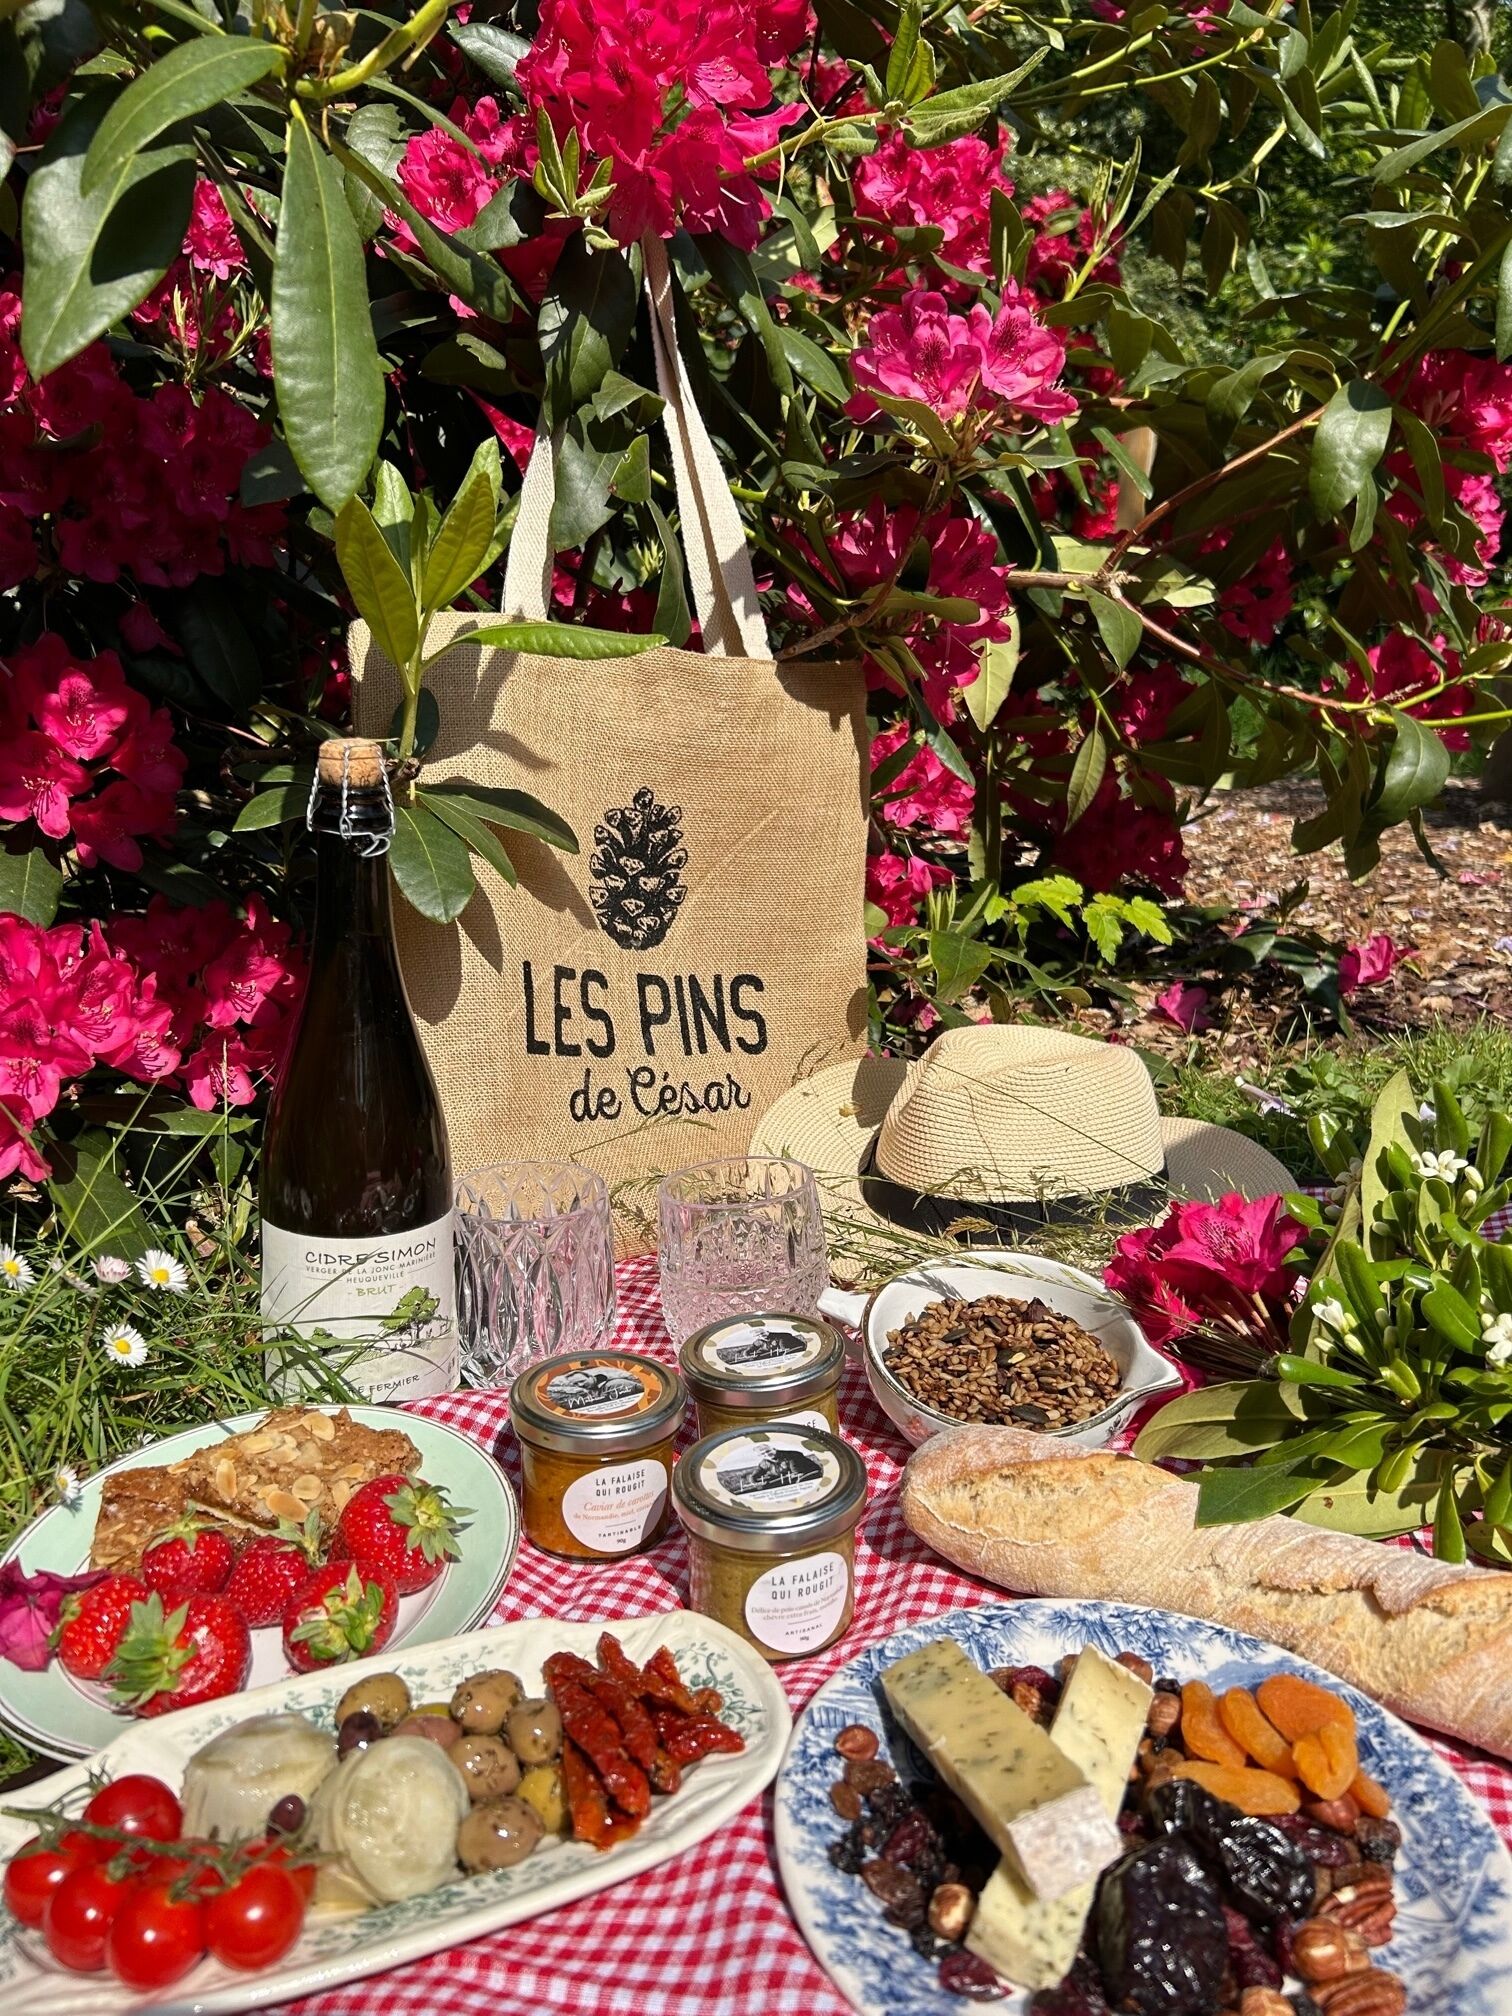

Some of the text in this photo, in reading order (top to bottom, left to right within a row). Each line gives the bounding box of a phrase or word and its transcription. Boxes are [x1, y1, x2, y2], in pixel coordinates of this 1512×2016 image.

[523, 960, 768, 1058] LES PINS
[569, 1065, 751, 1122] de César
[305, 1237, 436, 1266] CIDRE SIMON
[305, 1265, 338, 1275] VERGER
[371, 1265, 396, 1274] JONC
[346, 1271, 405, 1283] HEUQUEVILLE
[356, 1283, 397, 1297] BRUT
[369, 1374, 420, 1392] FERMIER
[596, 1469, 646, 1486] LA FALAISE
[596, 1480, 646, 1497] QUI ROUGIT
[583, 1501, 614, 1512] Caviar
[616, 1499, 626, 1510] de
[598, 1525, 642, 1538] TARTINABLE
[771, 1562, 835, 1586] LA FALAISE
[771, 1590, 791, 1600] QUI
[797, 1576, 834, 1598] ROUGIT
